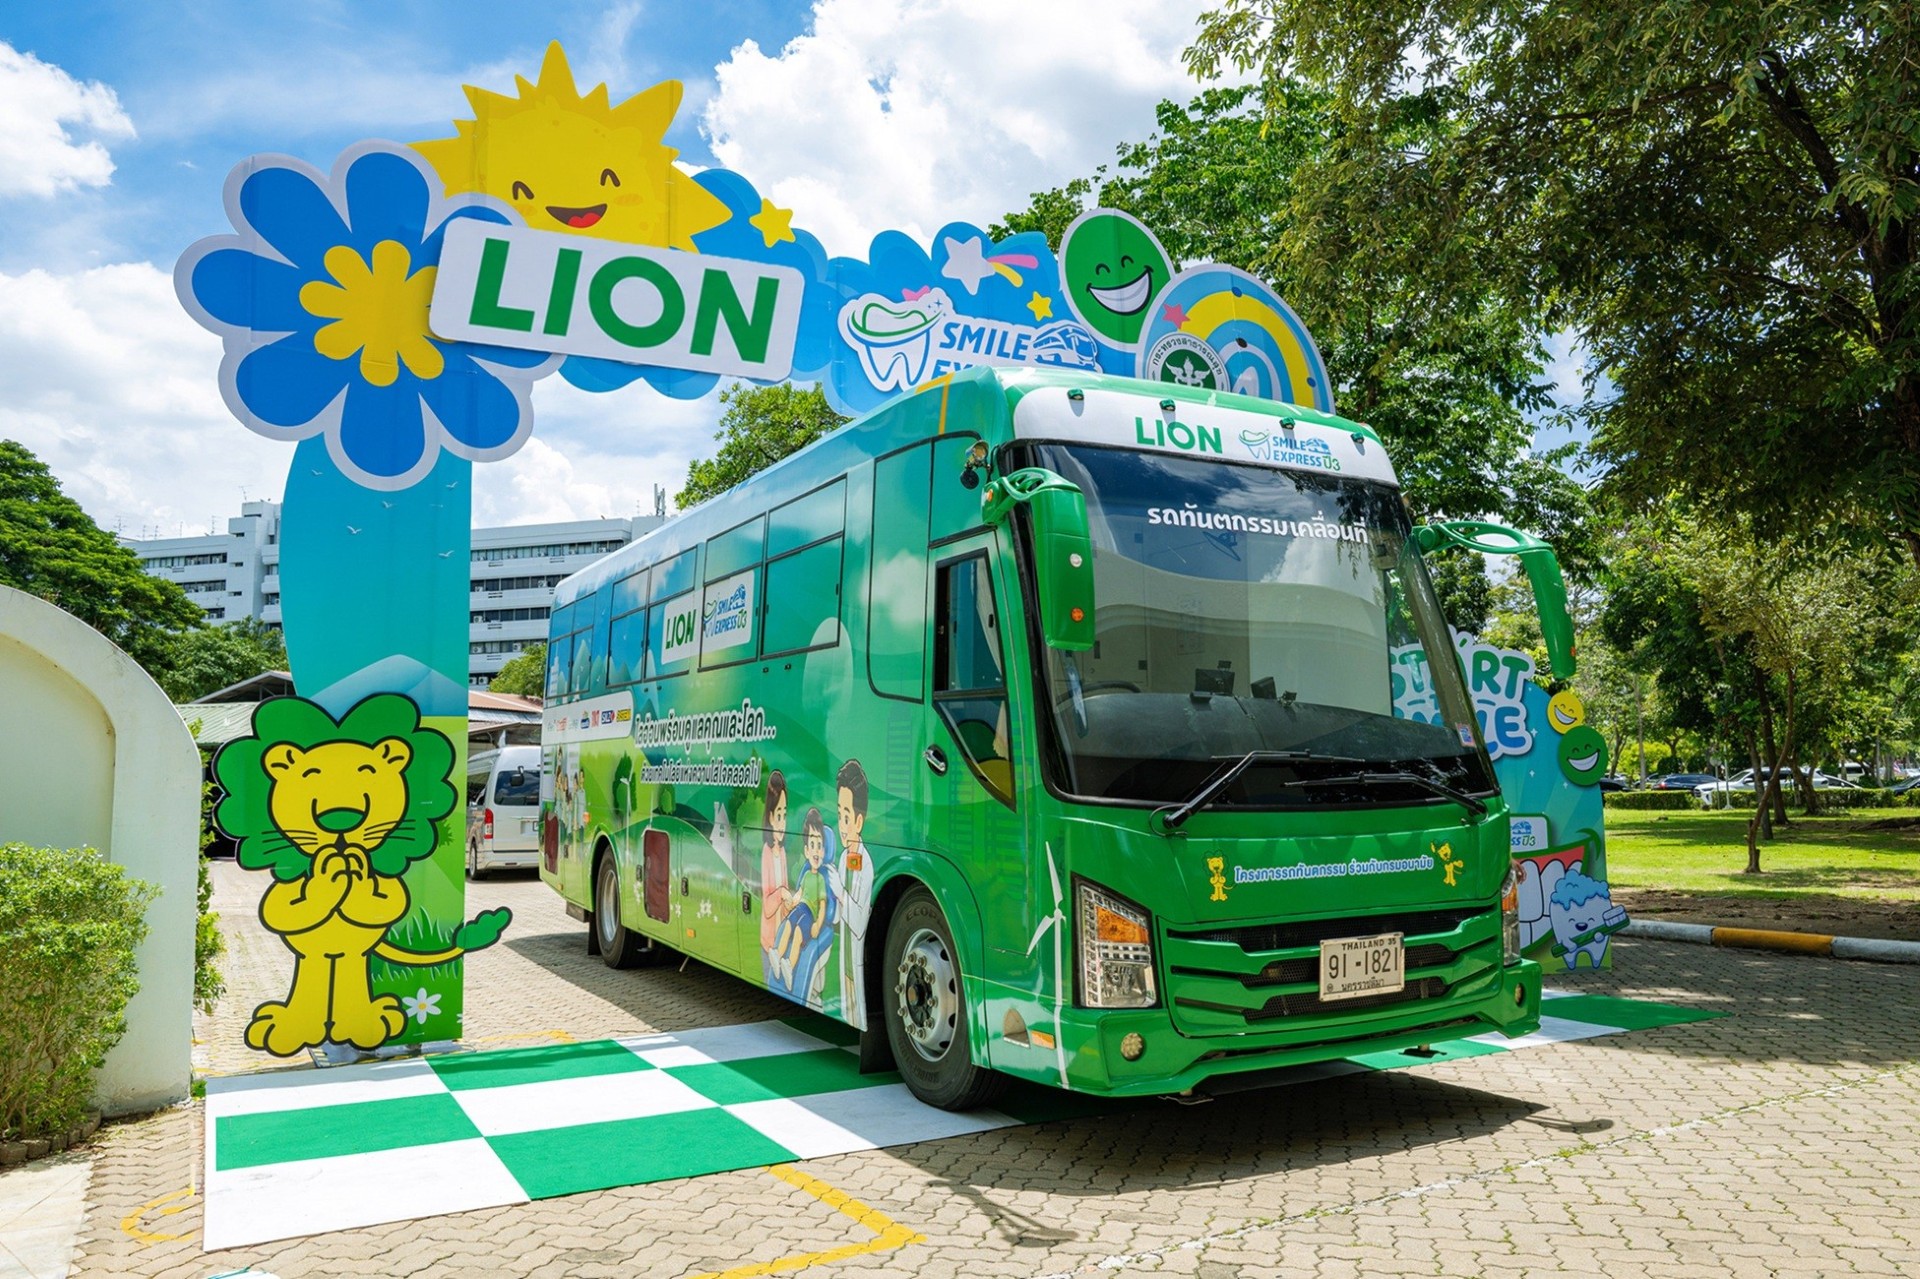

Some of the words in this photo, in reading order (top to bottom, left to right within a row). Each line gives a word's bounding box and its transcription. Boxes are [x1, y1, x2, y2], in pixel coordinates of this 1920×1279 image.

[468, 238, 780, 364] LION
[939, 322, 1032, 361] SMILE
[1152, 337, 1222, 376] กระทรวงสาธารณสุข
[1135, 417, 1222, 454] LION
[1273, 435, 1307, 451] SMILE
[1273, 450, 1322, 467] EXPRESS
[1147, 502, 1368, 544] รถทันตกรรมเคลื่อนที่
[717, 596, 734, 615] SMILE
[665, 609, 696, 649] LION
[715, 615, 737, 635] EXPRESS
[1235, 862, 1346, 883] โครงการรถทันตกรรม
[1349, 854, 1434, 876] ร่วมกับกรมอนามัย
[1342, 939, 1385, 950] THAILAND
